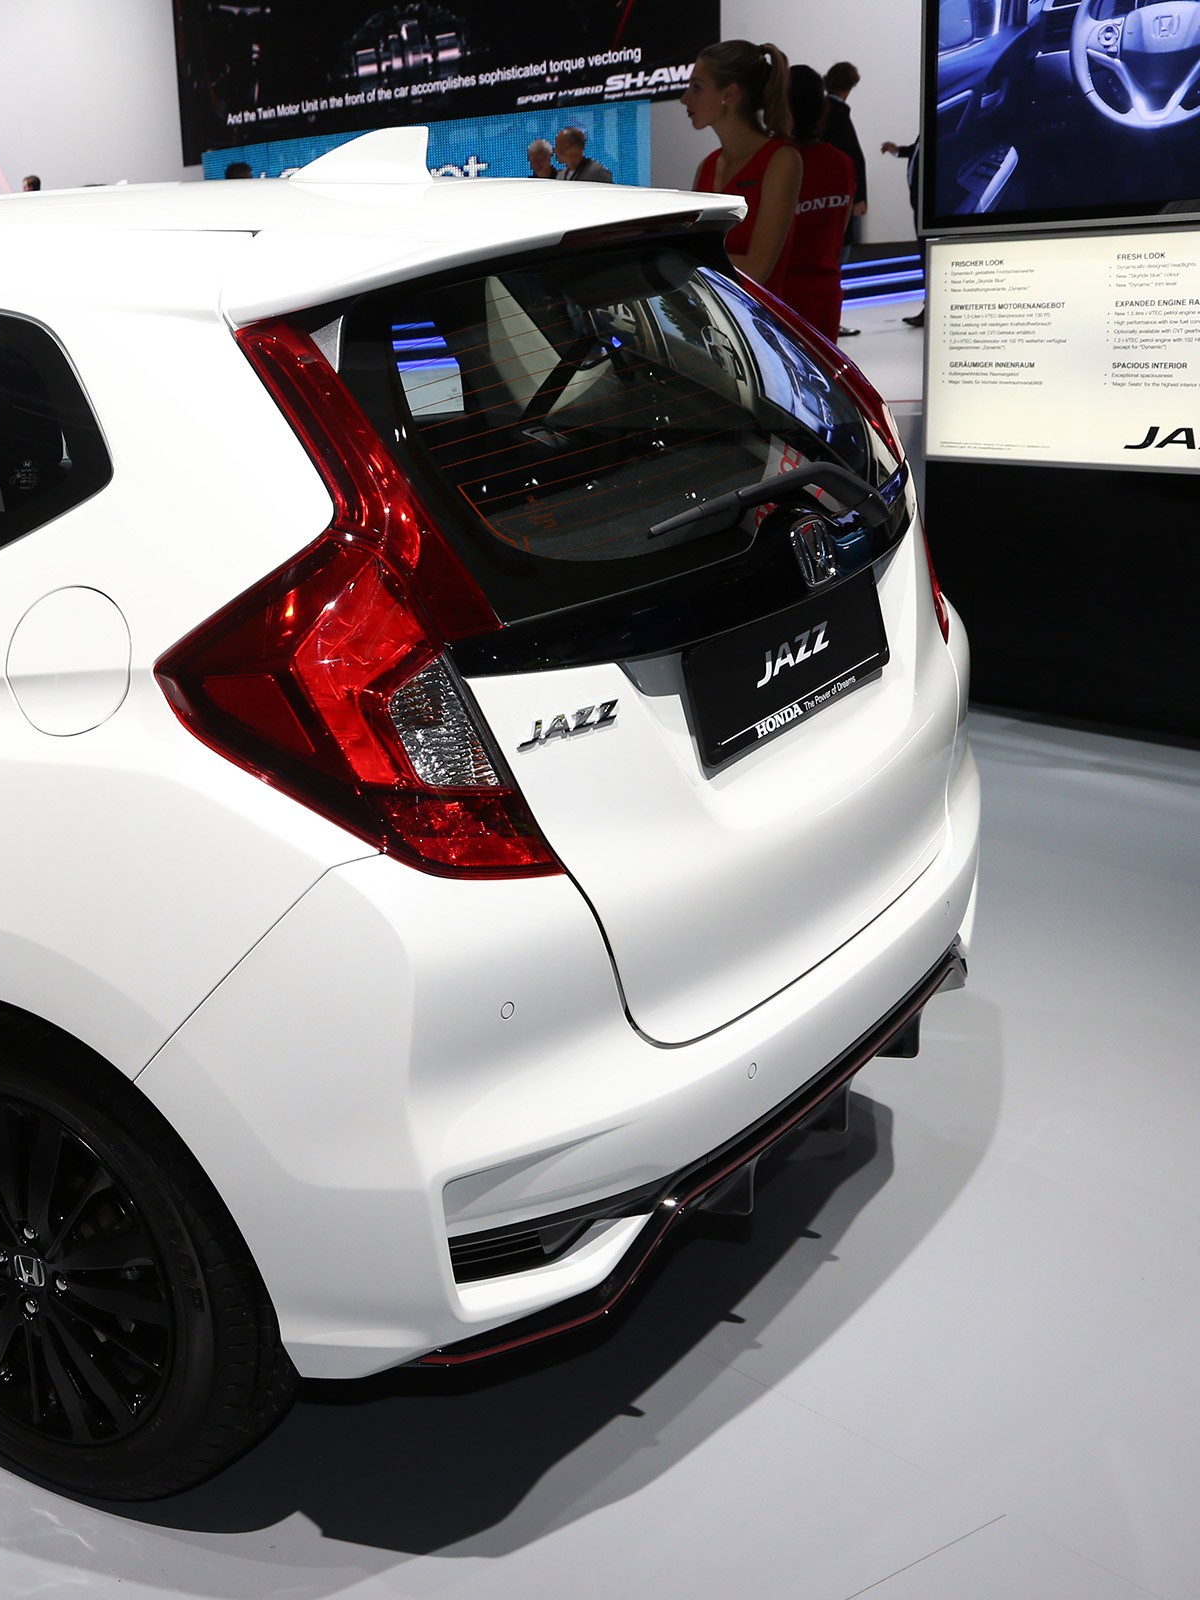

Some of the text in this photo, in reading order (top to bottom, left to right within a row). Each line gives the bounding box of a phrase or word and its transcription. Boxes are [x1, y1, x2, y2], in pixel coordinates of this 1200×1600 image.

[227, 47, 641, 125] And the Twin Motor Unit in the front of the car accomplishes sophisticated torque vectoring
[517, 92, 556, 105] SPORT
[604, 63, 696, 92] SH-AW
[604, 92, 623, 100] Super
[625, 86, 657, 97] Handling
[951, 260, 983, 268] FRISCHER
[1144, 252, 1166, 260] LOOK
[998, 302, 1066, 310] MOTORENANGEBOT
[1188, 298, 1200, 306] RA
[1123, 426, 1200, 450] JA
[757, 620, 830, 688] JAZZ
[755, 675, 857, 739] HONDA The Power of Dreams
[516, 699, 618, 752] JAZZ
